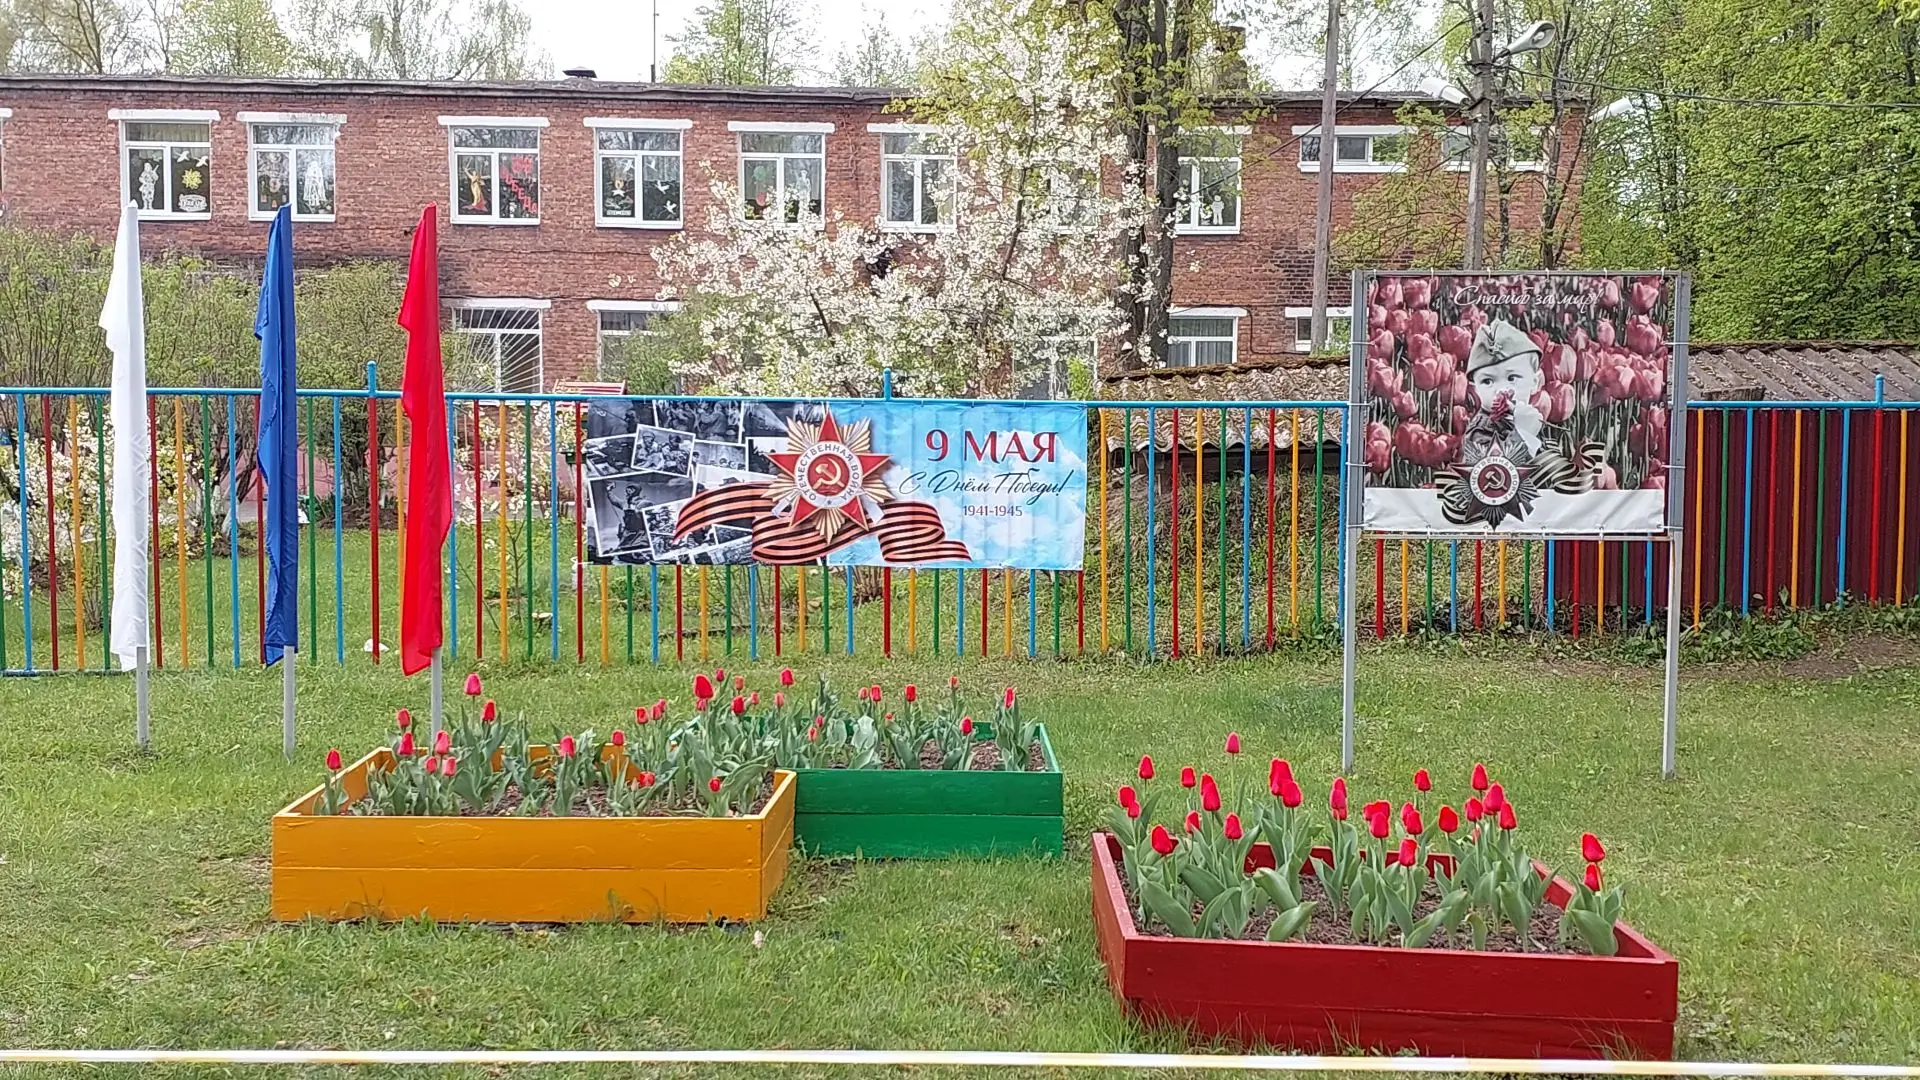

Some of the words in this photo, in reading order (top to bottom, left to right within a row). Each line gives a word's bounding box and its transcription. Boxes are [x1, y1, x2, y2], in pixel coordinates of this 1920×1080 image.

[1454, 285, 1534, 306] Спасибо
[1535, 294, 1555, 305] за
[926, 429, 949, 462] 9
[964, 430, 1058, 464] МАЯ
[798, 443, 853, 501] ОТЕЧЕСТВЕННАЯ
[840, 464, 860, 501] ВОЙНА
[928, 470, 991, 494] Днём
[963, 505, 1023, 517] 1941-1945
